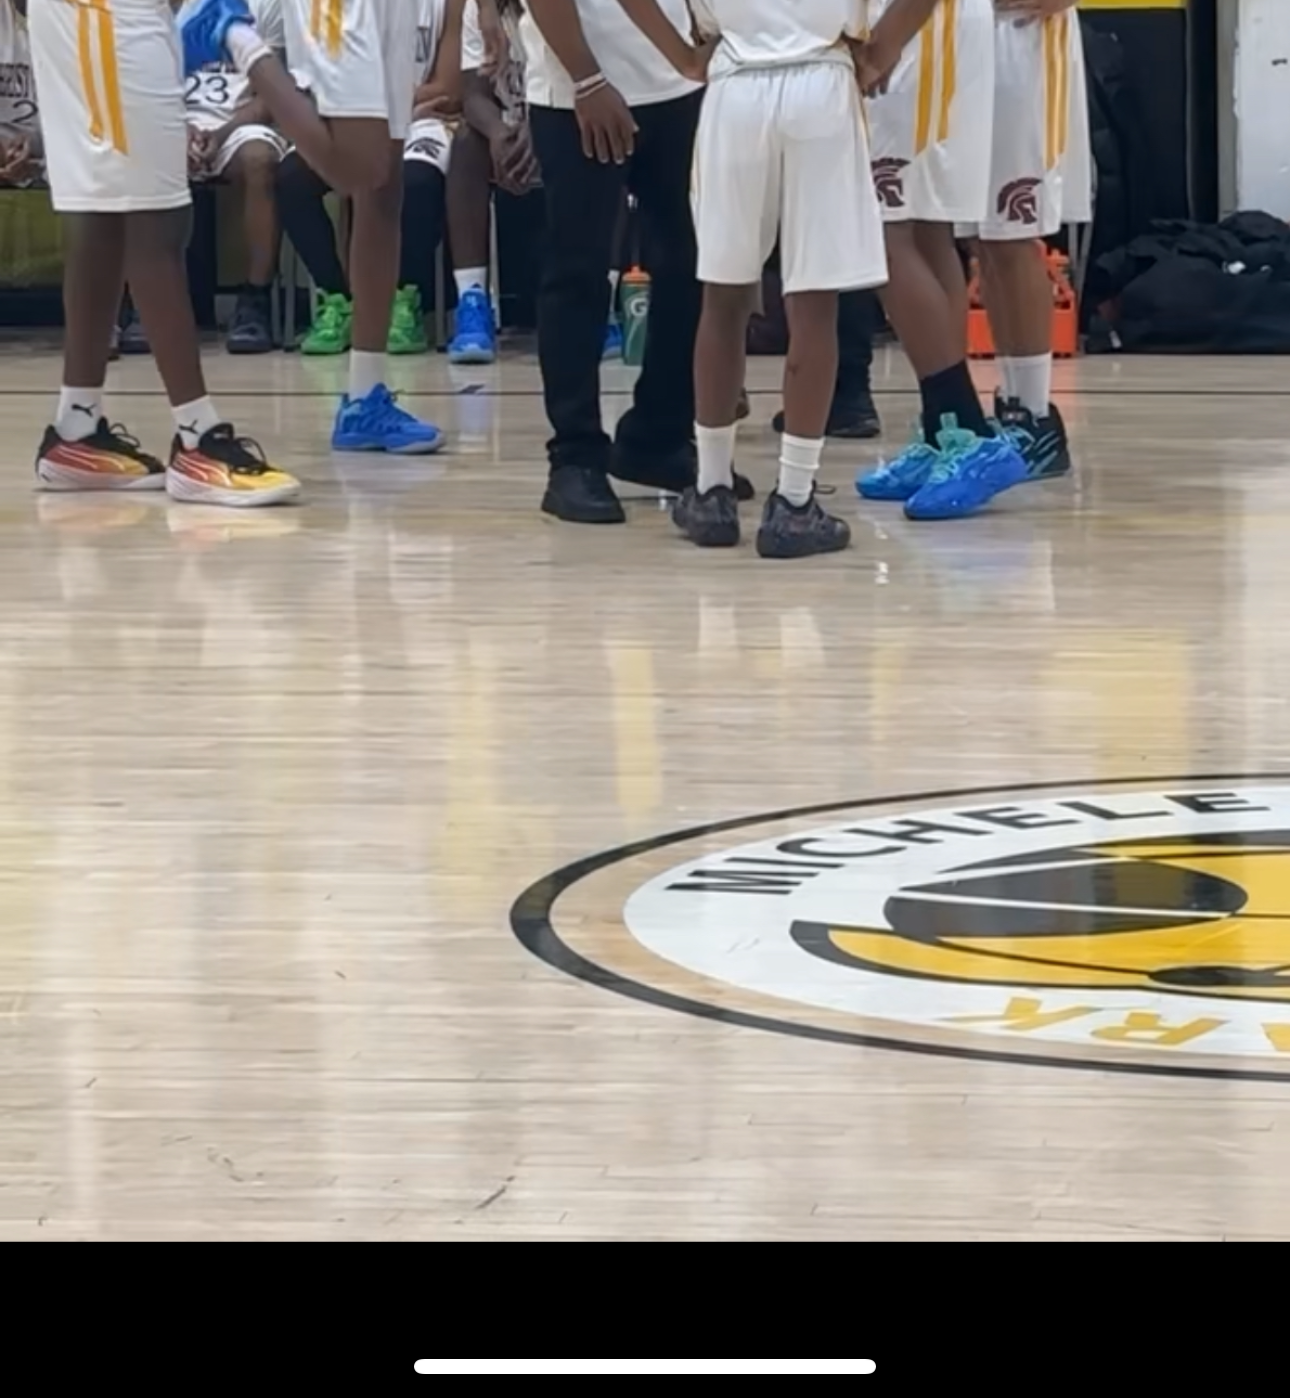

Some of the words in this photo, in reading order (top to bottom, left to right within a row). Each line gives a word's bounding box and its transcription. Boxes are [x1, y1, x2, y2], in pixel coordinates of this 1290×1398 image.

[183, 75, 230, 104] 23
[630, 297, 649, 317] G
[664, 791, 1271, 896] MICHELE
[937, 996, 1290, 1052] RK
